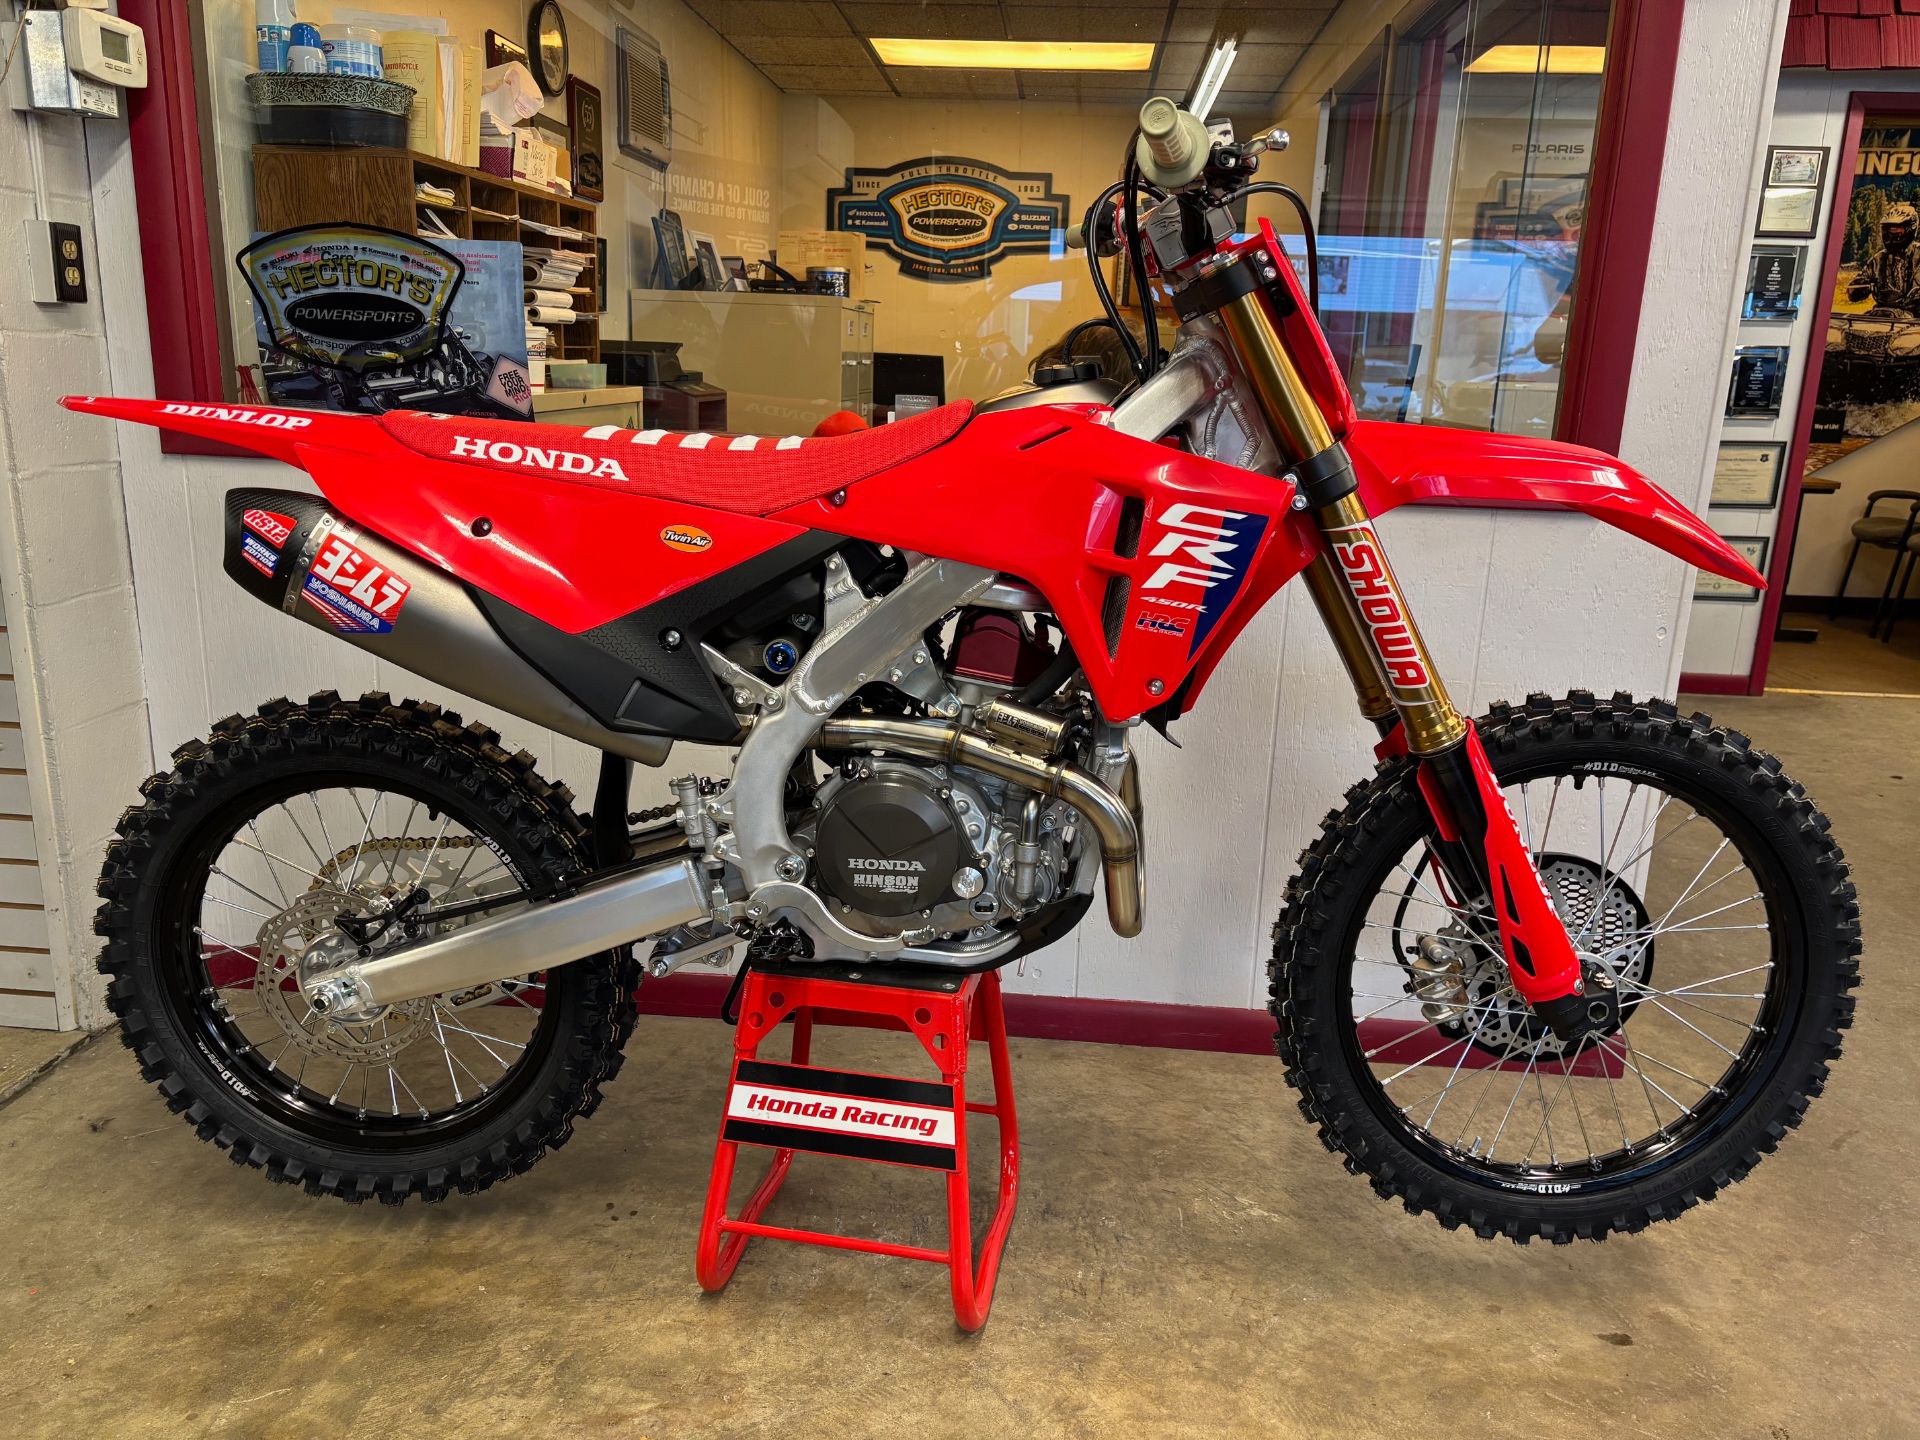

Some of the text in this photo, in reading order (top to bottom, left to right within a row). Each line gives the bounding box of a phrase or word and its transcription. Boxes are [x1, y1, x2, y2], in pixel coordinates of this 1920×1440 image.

[385, 62, 419, 71] MOTORCYCLE
[1511, 144, 1585, 154] POLARIS
[900, 166, 1000, 183] FULL THROTTLE
[856, 180, 881, 189] SINCE
[900, 189, 996, 216] HECTOR'S
[912, 217, 983, 227] POWERSPORTS
[1020, 214, 1051, 222] SUZUKI
[910, 230, 986, 244] hectorspowersports.com
[268, 250, 300, 266] SUZUKI
[368, 247, 398, 259] Kawasaki
[410, 258, 443, 278] POLARIS
[269, 259, 434, 304] HECTOR'S
[294, 307, 416, 323] POWERSPORTS
[497, 369, 520, 382] FREE
[501, 376, 525, 389] YOUR
[156, 403, 312, 430] DUNLOP
[450, 436, 629, 481] HONDA
[664, 530, 711, 547] Twin Air
[1141, 503, 1248, 588] CRF
[244, 537, 277, 562] WORKS
[244, 545, 274, 568] EDITION
[313, 539, 408, 614] ヨシムラ
[308, 576, 380, 629] YOSHIMURA
[1140, 596, 1208, 613] 450R
[1137, 611, 1190, 634] HRC
[1334, 541, 1429, 688] SHOWA
[847, 858, 926, 871] HONDA
[853, 874, 919, 886] HINSON
[746, 1093, 938, 1137] Honda Racing
